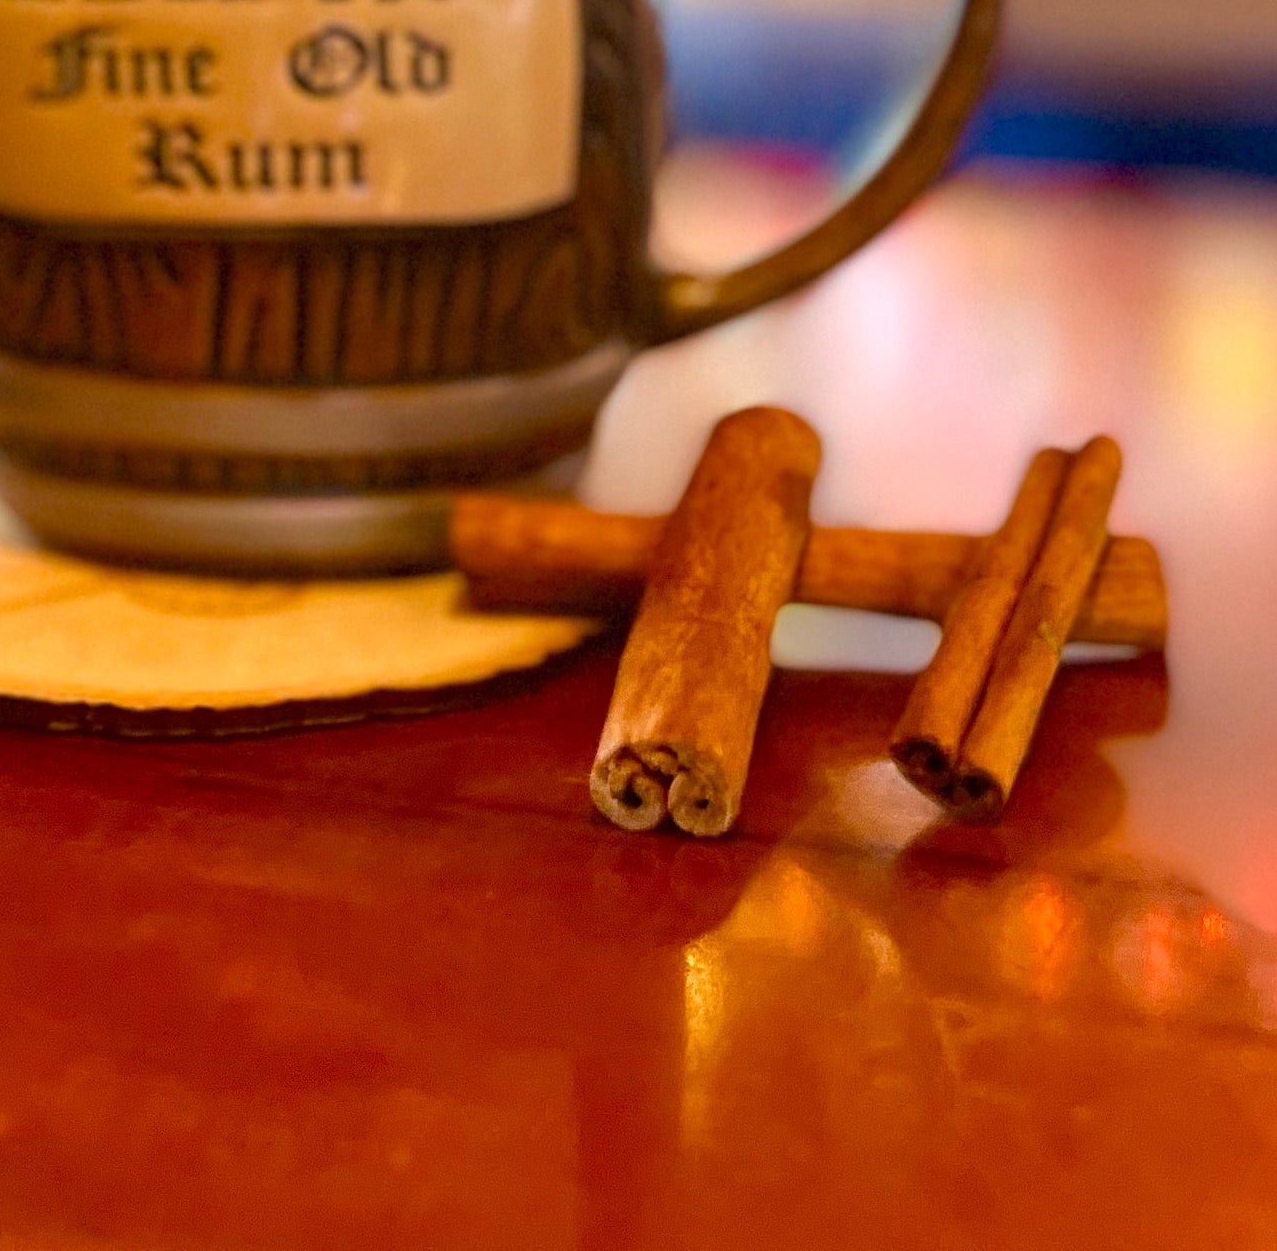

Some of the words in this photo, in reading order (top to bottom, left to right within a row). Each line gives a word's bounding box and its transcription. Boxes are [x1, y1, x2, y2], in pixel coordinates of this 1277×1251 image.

[28, 23, 221, 104] Fine
[287, 22, 453, 99] Old
[135, 115, 368, 193] Rum
